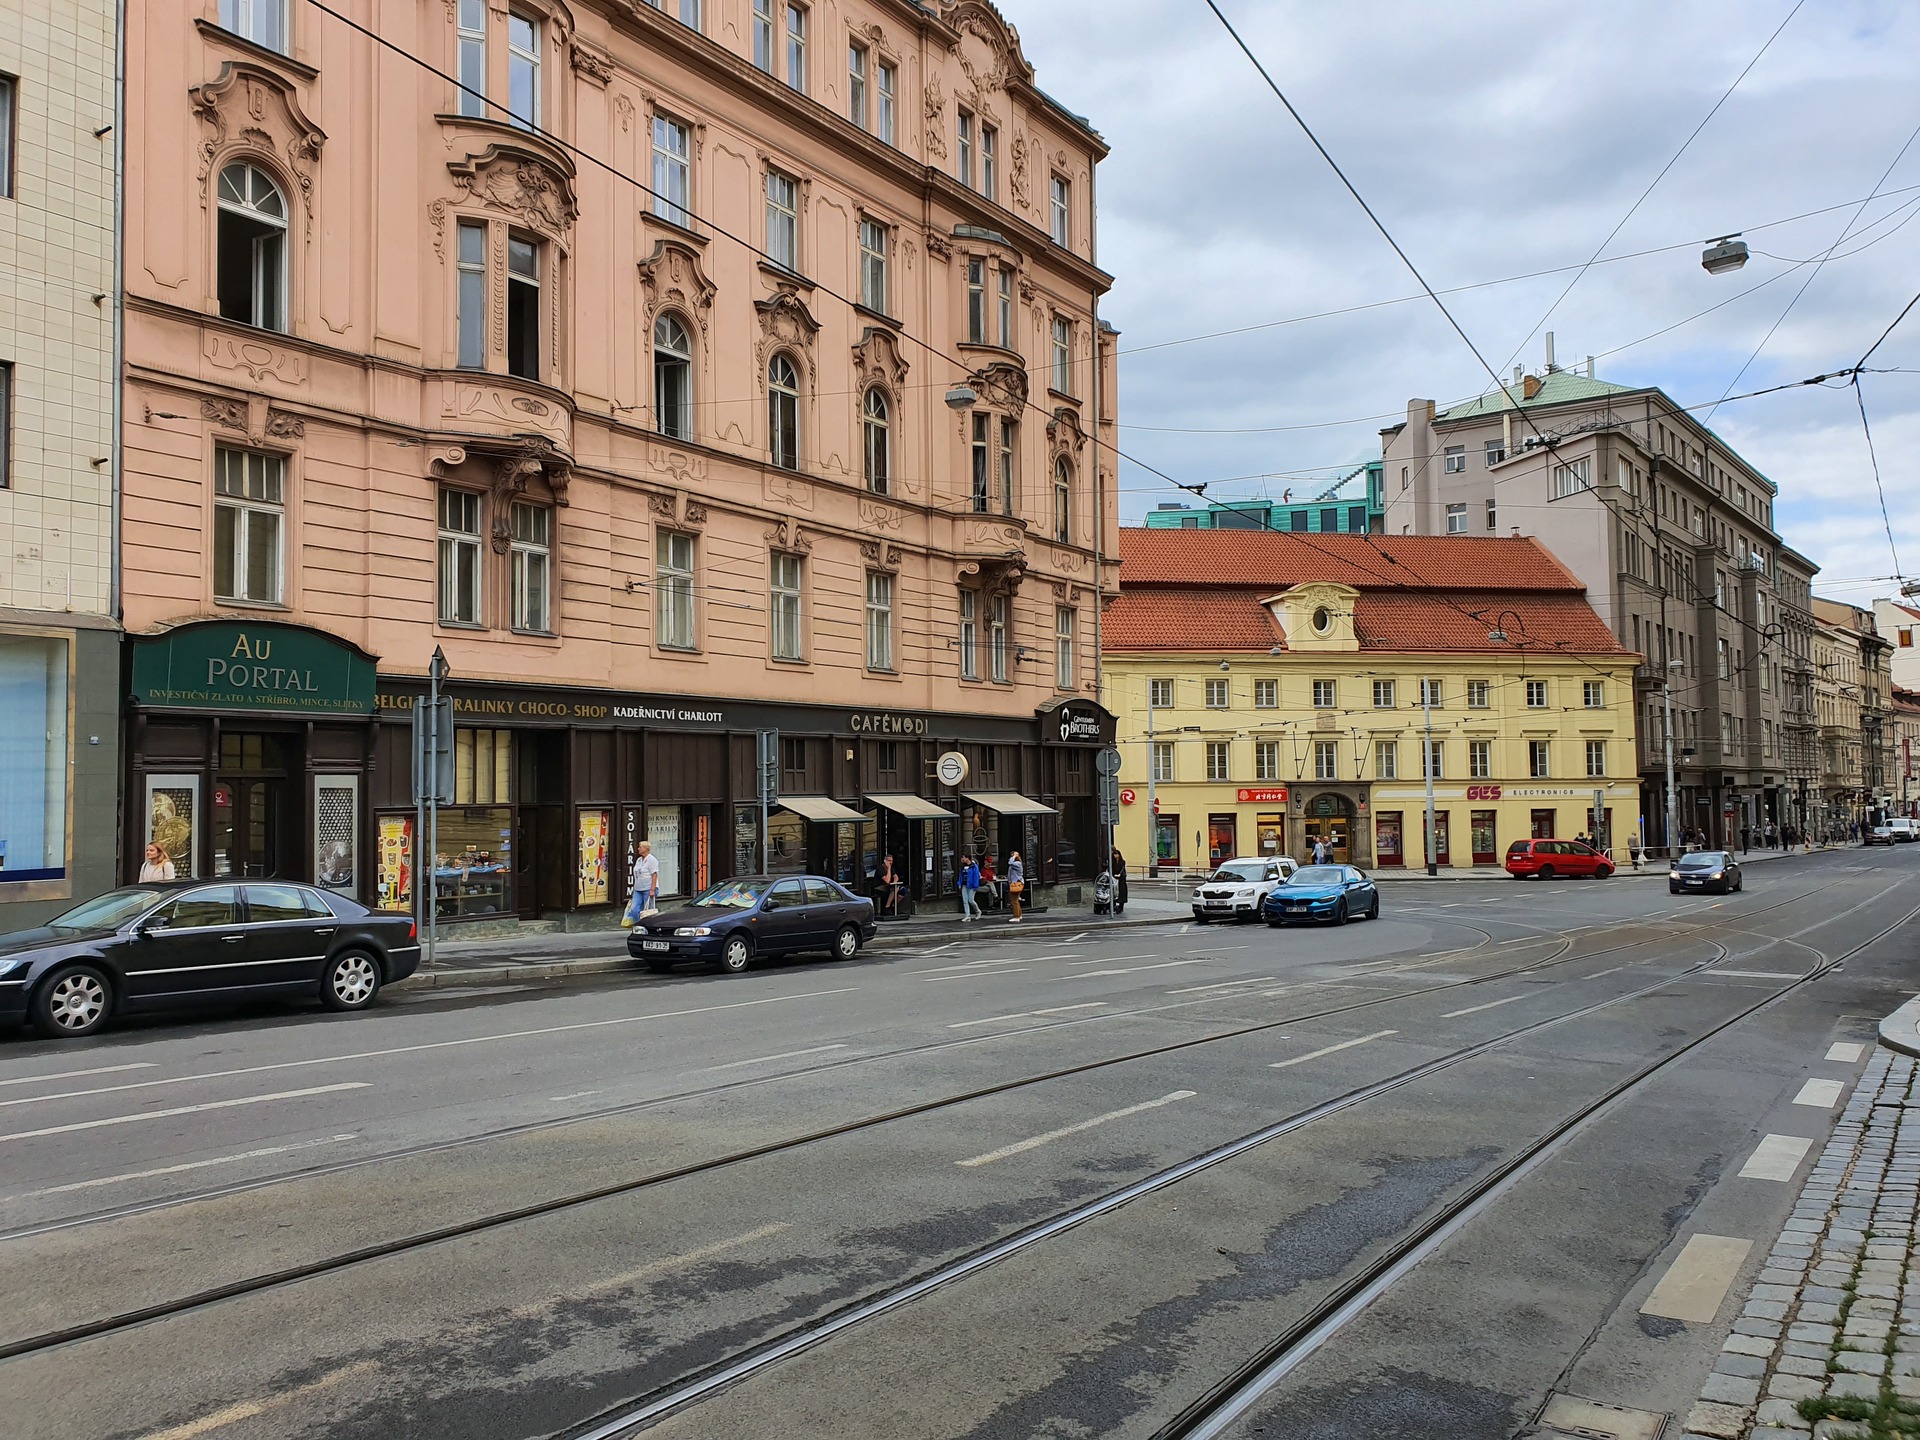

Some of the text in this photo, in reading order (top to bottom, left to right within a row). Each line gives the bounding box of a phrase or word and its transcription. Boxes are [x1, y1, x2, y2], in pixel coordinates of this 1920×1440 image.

[206, 657, 319, 692] PORTAL
[149, 688, 209, 701] INVESTIČNÍ
[211, 692, 244, 703] ZLATO
[248, 695, 253, 703] A
[255, 693, 299, 707] STŘÍBRO,
[301, 697, 332, 708] MINCE,
[374, 694, 413, 709] BELGI
[453, 698, 514, 714] RALINKY
[573, 704, 608, 718] SHOP
[613, 705, 723, 722] KADEŘNICTVÍ CHARLOTT
[1070, 721, 1100, 735] BROTHERS
[626, 811, 635, 897] SOLÁRIUM
